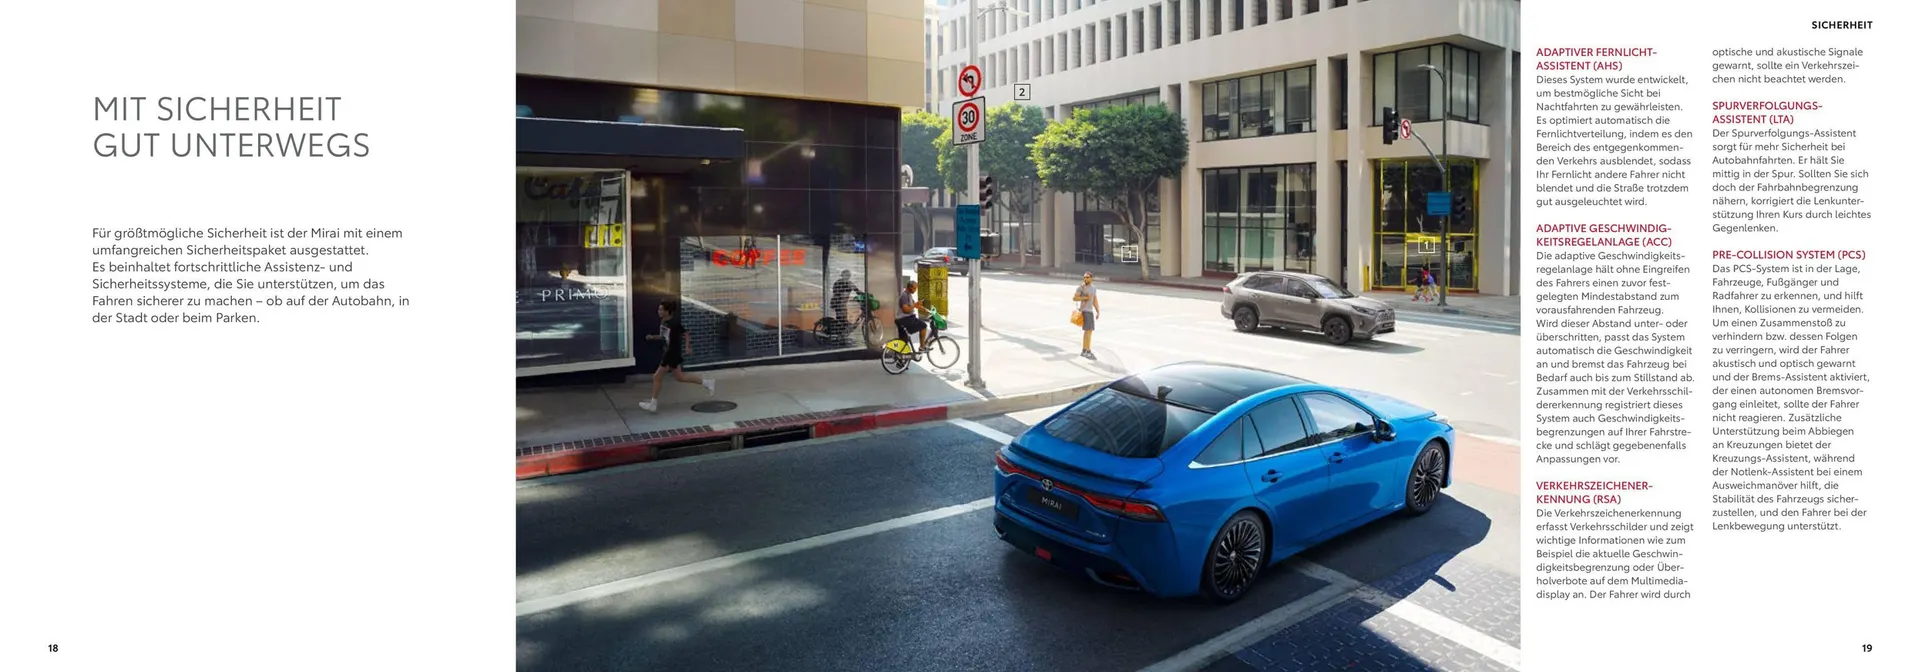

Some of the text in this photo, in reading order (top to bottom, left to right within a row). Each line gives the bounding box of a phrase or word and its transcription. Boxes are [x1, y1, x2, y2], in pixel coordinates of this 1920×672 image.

[1811, 21, 1873, 29] SICHERHEIT
[1535, 48, 1657, 56] ADAPTIVER FERNLICHT-
[1535, 61, 1623, 71] ASSISTENT (AHS)
[1569, 76, 1603, 85] System
[1605, 76, 1636, 84] wurde
[1637, 76, 1689, 84] entwickelt,
[1553, 89, 1619, 99] bestmögliche
[1620, 89, 1644, 97] Sicht
[1646, 89, 1661, 97] bei
[94, 97, 342, 121] MIT SICHERHEIT
[1536, 102, 1599, 111] Nachtfahrten
[1613, 103, 1683, 113] gewährleisten.
[1712, 101, 1823, 110] SPURVERFOLGUNGS-
[962, 110, 975, 125] 30
[1536, 116, 1671, 126] Es optimiert automatisch die
[1712, 115, 1794, 125] ASSISTENT (LTA)
[960, 132, 978, 142] ZONE
[1536, 130, 1627, 140] Fernlichtverteilung,
[1629, 130, 1659, 138] indem
[1674, 130, 1693, 138] den
[1712, 129, 1857, 139] Der Spurverfolgungs-Assistent
[93, 133, 370, 157] GUT UNTERWEGS
[1712, 144, 1737, 153] sorgt
[1738, 142, 1753, 150] für
[1781, 142, 1829, 151] Sicherheit
[1831, 143, 1846, 151] bei
[1712, 156, 1845, 164] Autobahnfahrten. Er hält Sie
[1535, 224, 1672, 232] ADAPTIVE GESCHWINDIG-
[92, 228, 403, 241] Für größtmögliche Sicherheit ist der Mirai mit einem
[1536, 237, 1672, 247] KEITSREGELANLAGE (ACC)
[92, 245, 369, 258] umfangreichen Sicherheitspaket ausgestattet.
[1712, 250, 1866, 260] PRE-COLLISION SYSTEM (PCS)
[92, 261, 353, 272] Es beinhaltet fortschrittliche Assistenz- und
[92, 278, 385, 291] Sicherheitssysteme, die Sie unterstützen, um das
[542, 288, 607, 303] PRIMO
[92, 295, 410, 307] Fahren sicherer zu machen ob auf der Autobahn, in
[91, 312, 260, 323] der Stadt oder beim Parken.
[1536, 387, 1693, 395] Zusammen mit der Verkehrsschil-
[1536, 401, 1683, 411] dererkennung registriert dieses
[1536, 414, 1685, 424] System auch Geschwindigkeits-
[1536, 428, 1692, 438] begrenzungen auf Ihrer Fahrstre-
[1712, 468, 1863, 476] der Notlenk-Assistent bei einem
[1535, 481, 1653, 490] VERKEHRSZEICHENER-
[1712, 481, 1839, 490] Ausweichmanöver hilft, die
[1041, 496, 1062, 511] MIRAI
[1536, 495, 1622, 504] KENNUNG (RSA)
[1712, 495, 1859, 505] Stabilität des Fahrzeugs sicher-
[1712, 508, 1757, 517] zustellen,
[1780, 508, 1799, 516] den
[1801, 508, 1832, 516] Fahrer
[1833, 508, 1849, 516] bei
[1850, 508, 1867, 516] der
[1712, 522, 1842, 532] Lenkbewegung unterstützt.
[1536, 550, 1683, 559] Beispiel die aktuelle Geschwin-
[1535, 562, 1684, 573] digkeitsbegrenzung oder Über-
[1536, 576, 1688, 585] holverbote auf dem Multimedia-
[1535, 590, 1571, 600] display
[1589, 590, 1607, 598] Der
[1609, 590, 1639, 598] Fahrer
[1640, 590, 1661, 598] wird
[1663, 590, 1691, 598] durch
[47, 644, 59, 652] 18
[1861, 644, 1873, 652] 19
